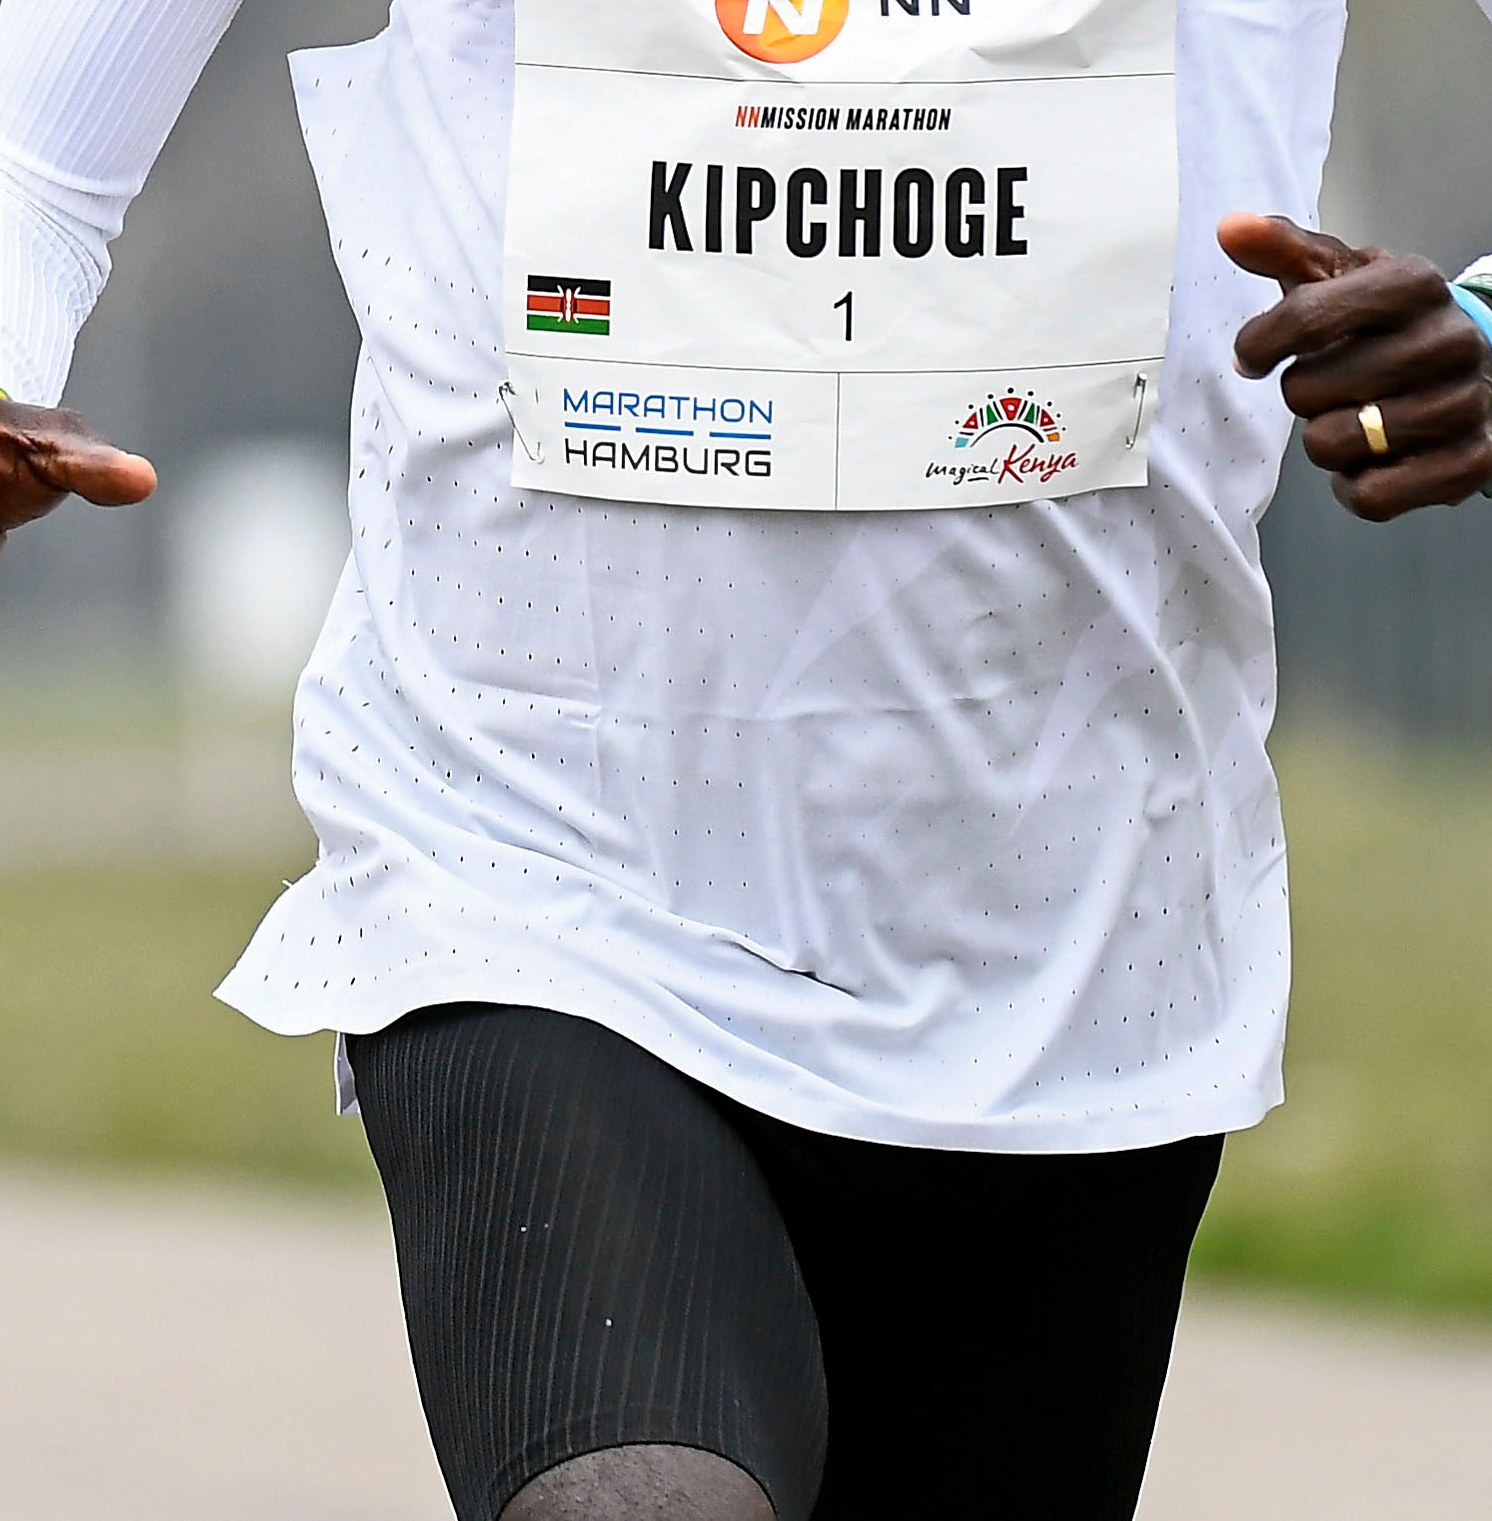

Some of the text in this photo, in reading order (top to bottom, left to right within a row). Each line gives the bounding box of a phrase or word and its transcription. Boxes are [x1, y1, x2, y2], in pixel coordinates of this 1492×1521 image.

[845, 107, 952, 131] MARATHON
[648, 160, 1028, 259] KIPCHOGE
[833, 291, 854, 342] 1
[563, 388, 773, 424] MARATHON
[564, 437, 772, 477] HAMBURG
[997, 443, 1078, 485] Kenya
